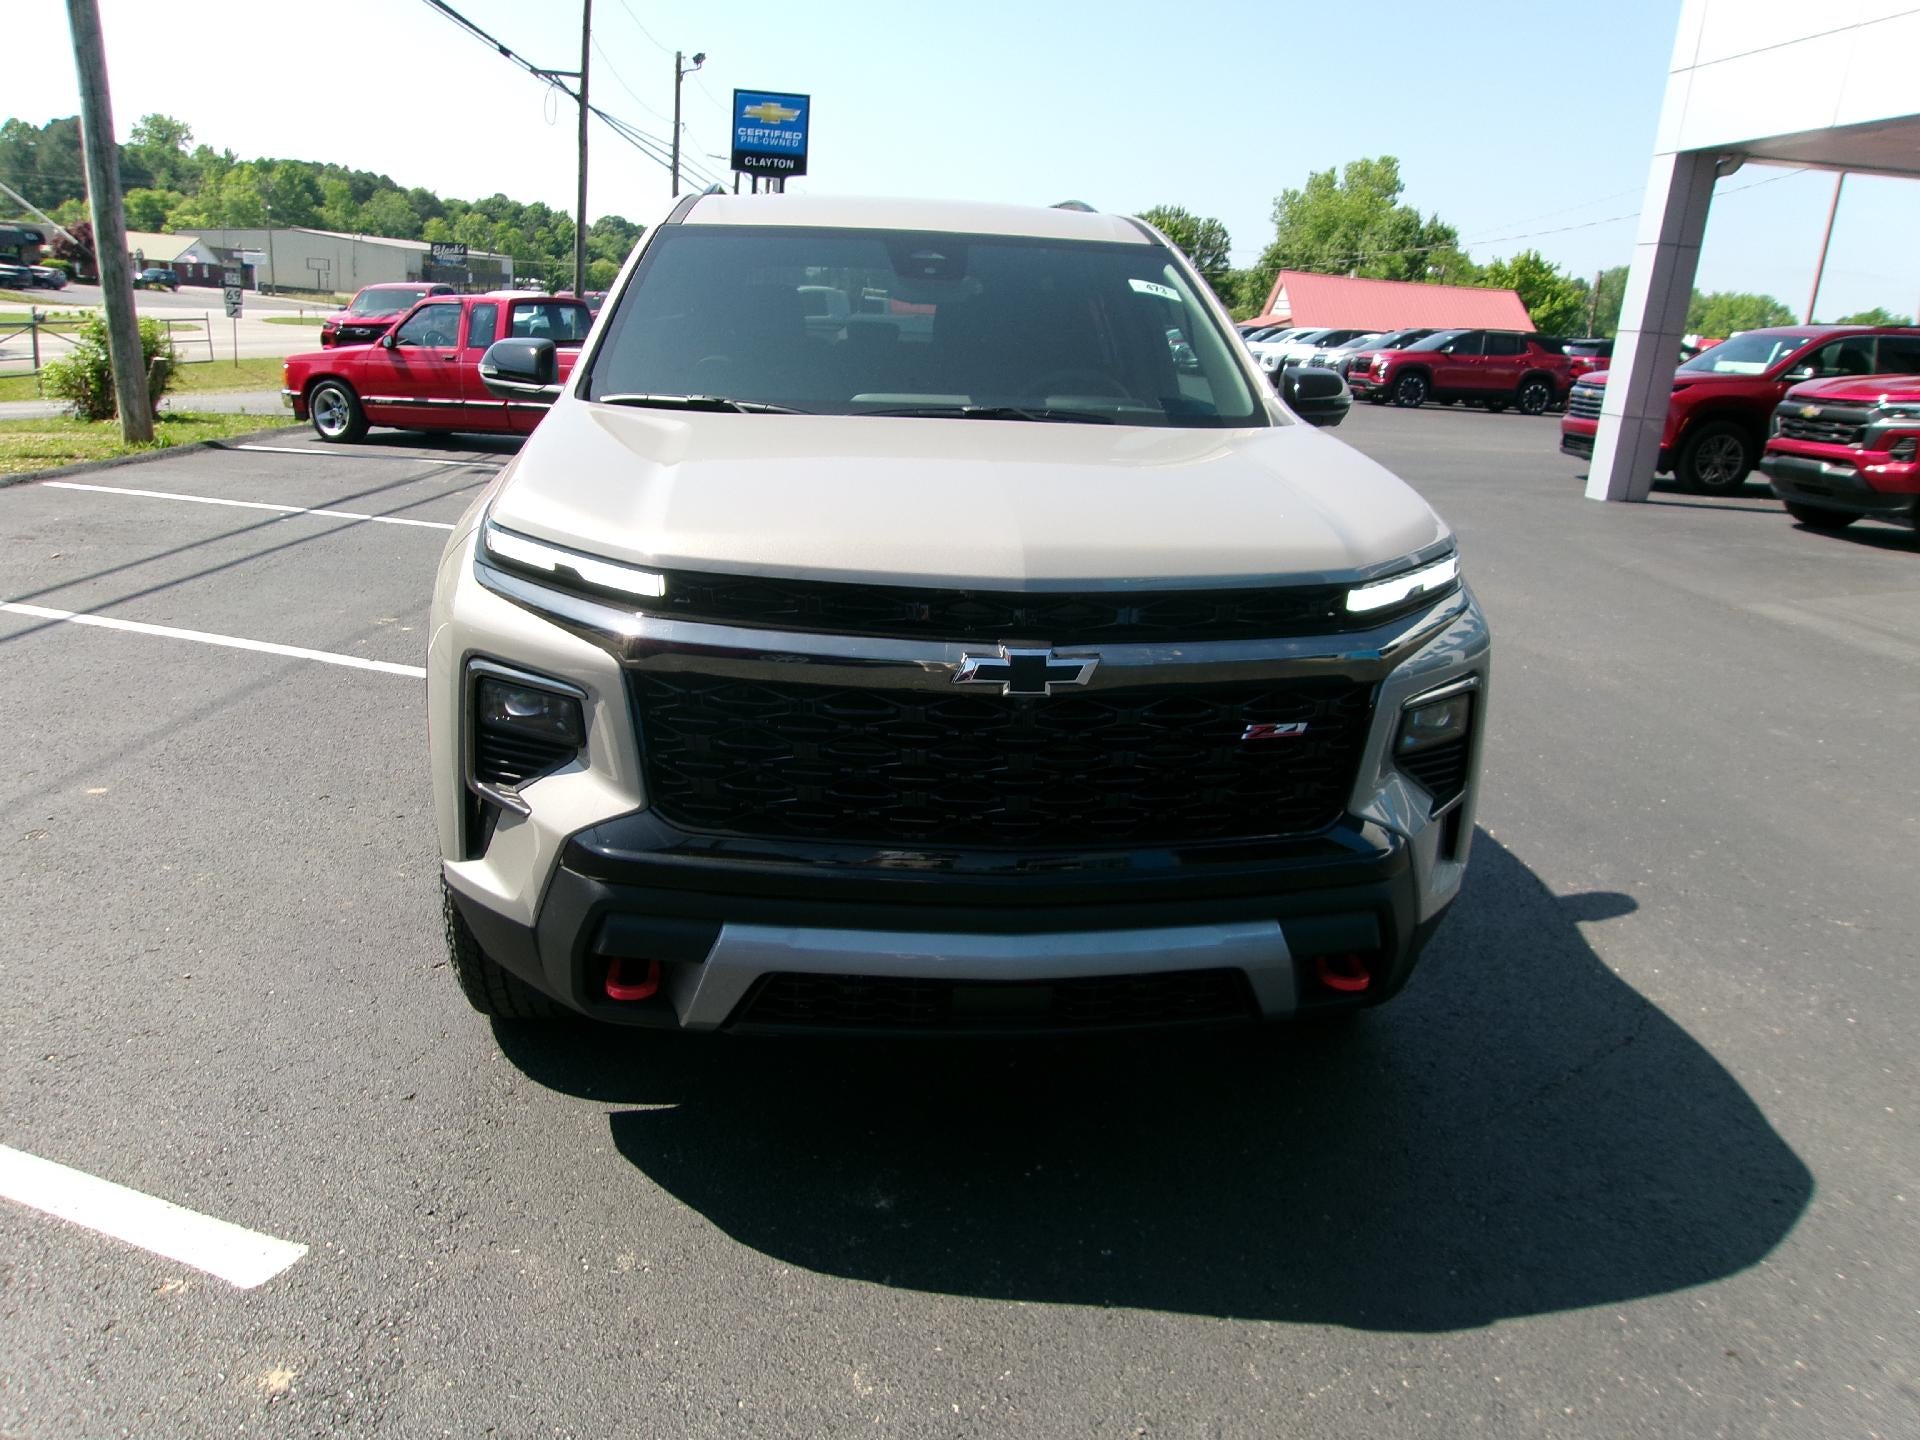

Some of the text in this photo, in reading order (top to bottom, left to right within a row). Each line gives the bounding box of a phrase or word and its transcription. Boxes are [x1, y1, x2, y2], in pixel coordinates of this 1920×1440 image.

[738, 127, 802, 140] CERTIFIED
[741, 135, 799, 147] PRE-OWNED
[744, 156, 794, 169] CLAYTON
[226, 289, 241, 300] 69
[1241, 722, 1308, 739] Z71
